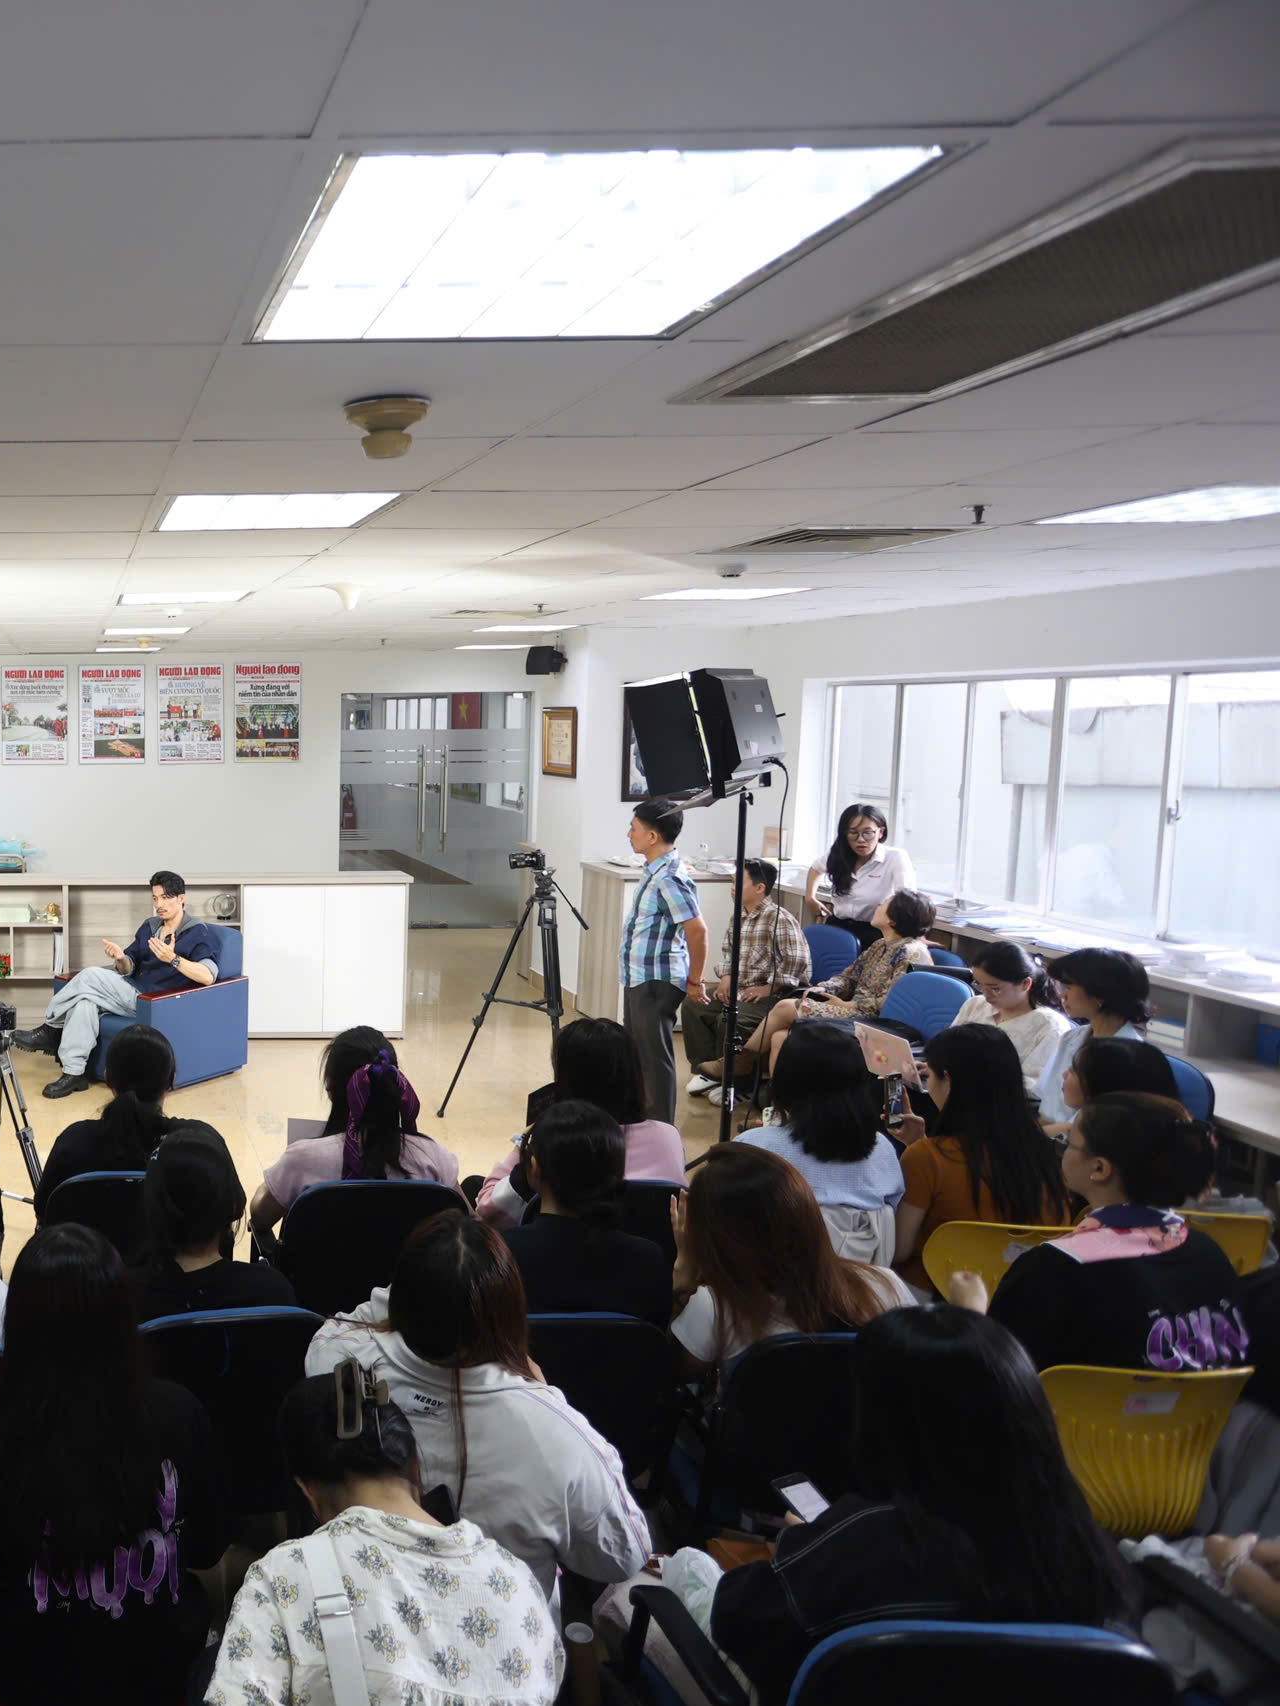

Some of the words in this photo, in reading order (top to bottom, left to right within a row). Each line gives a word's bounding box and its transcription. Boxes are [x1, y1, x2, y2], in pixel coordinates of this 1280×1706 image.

[29, 670, 42, 678] LAO
[106, 670, 120, 678] LAO
[414, 1393, 444, 1407] NERDY
